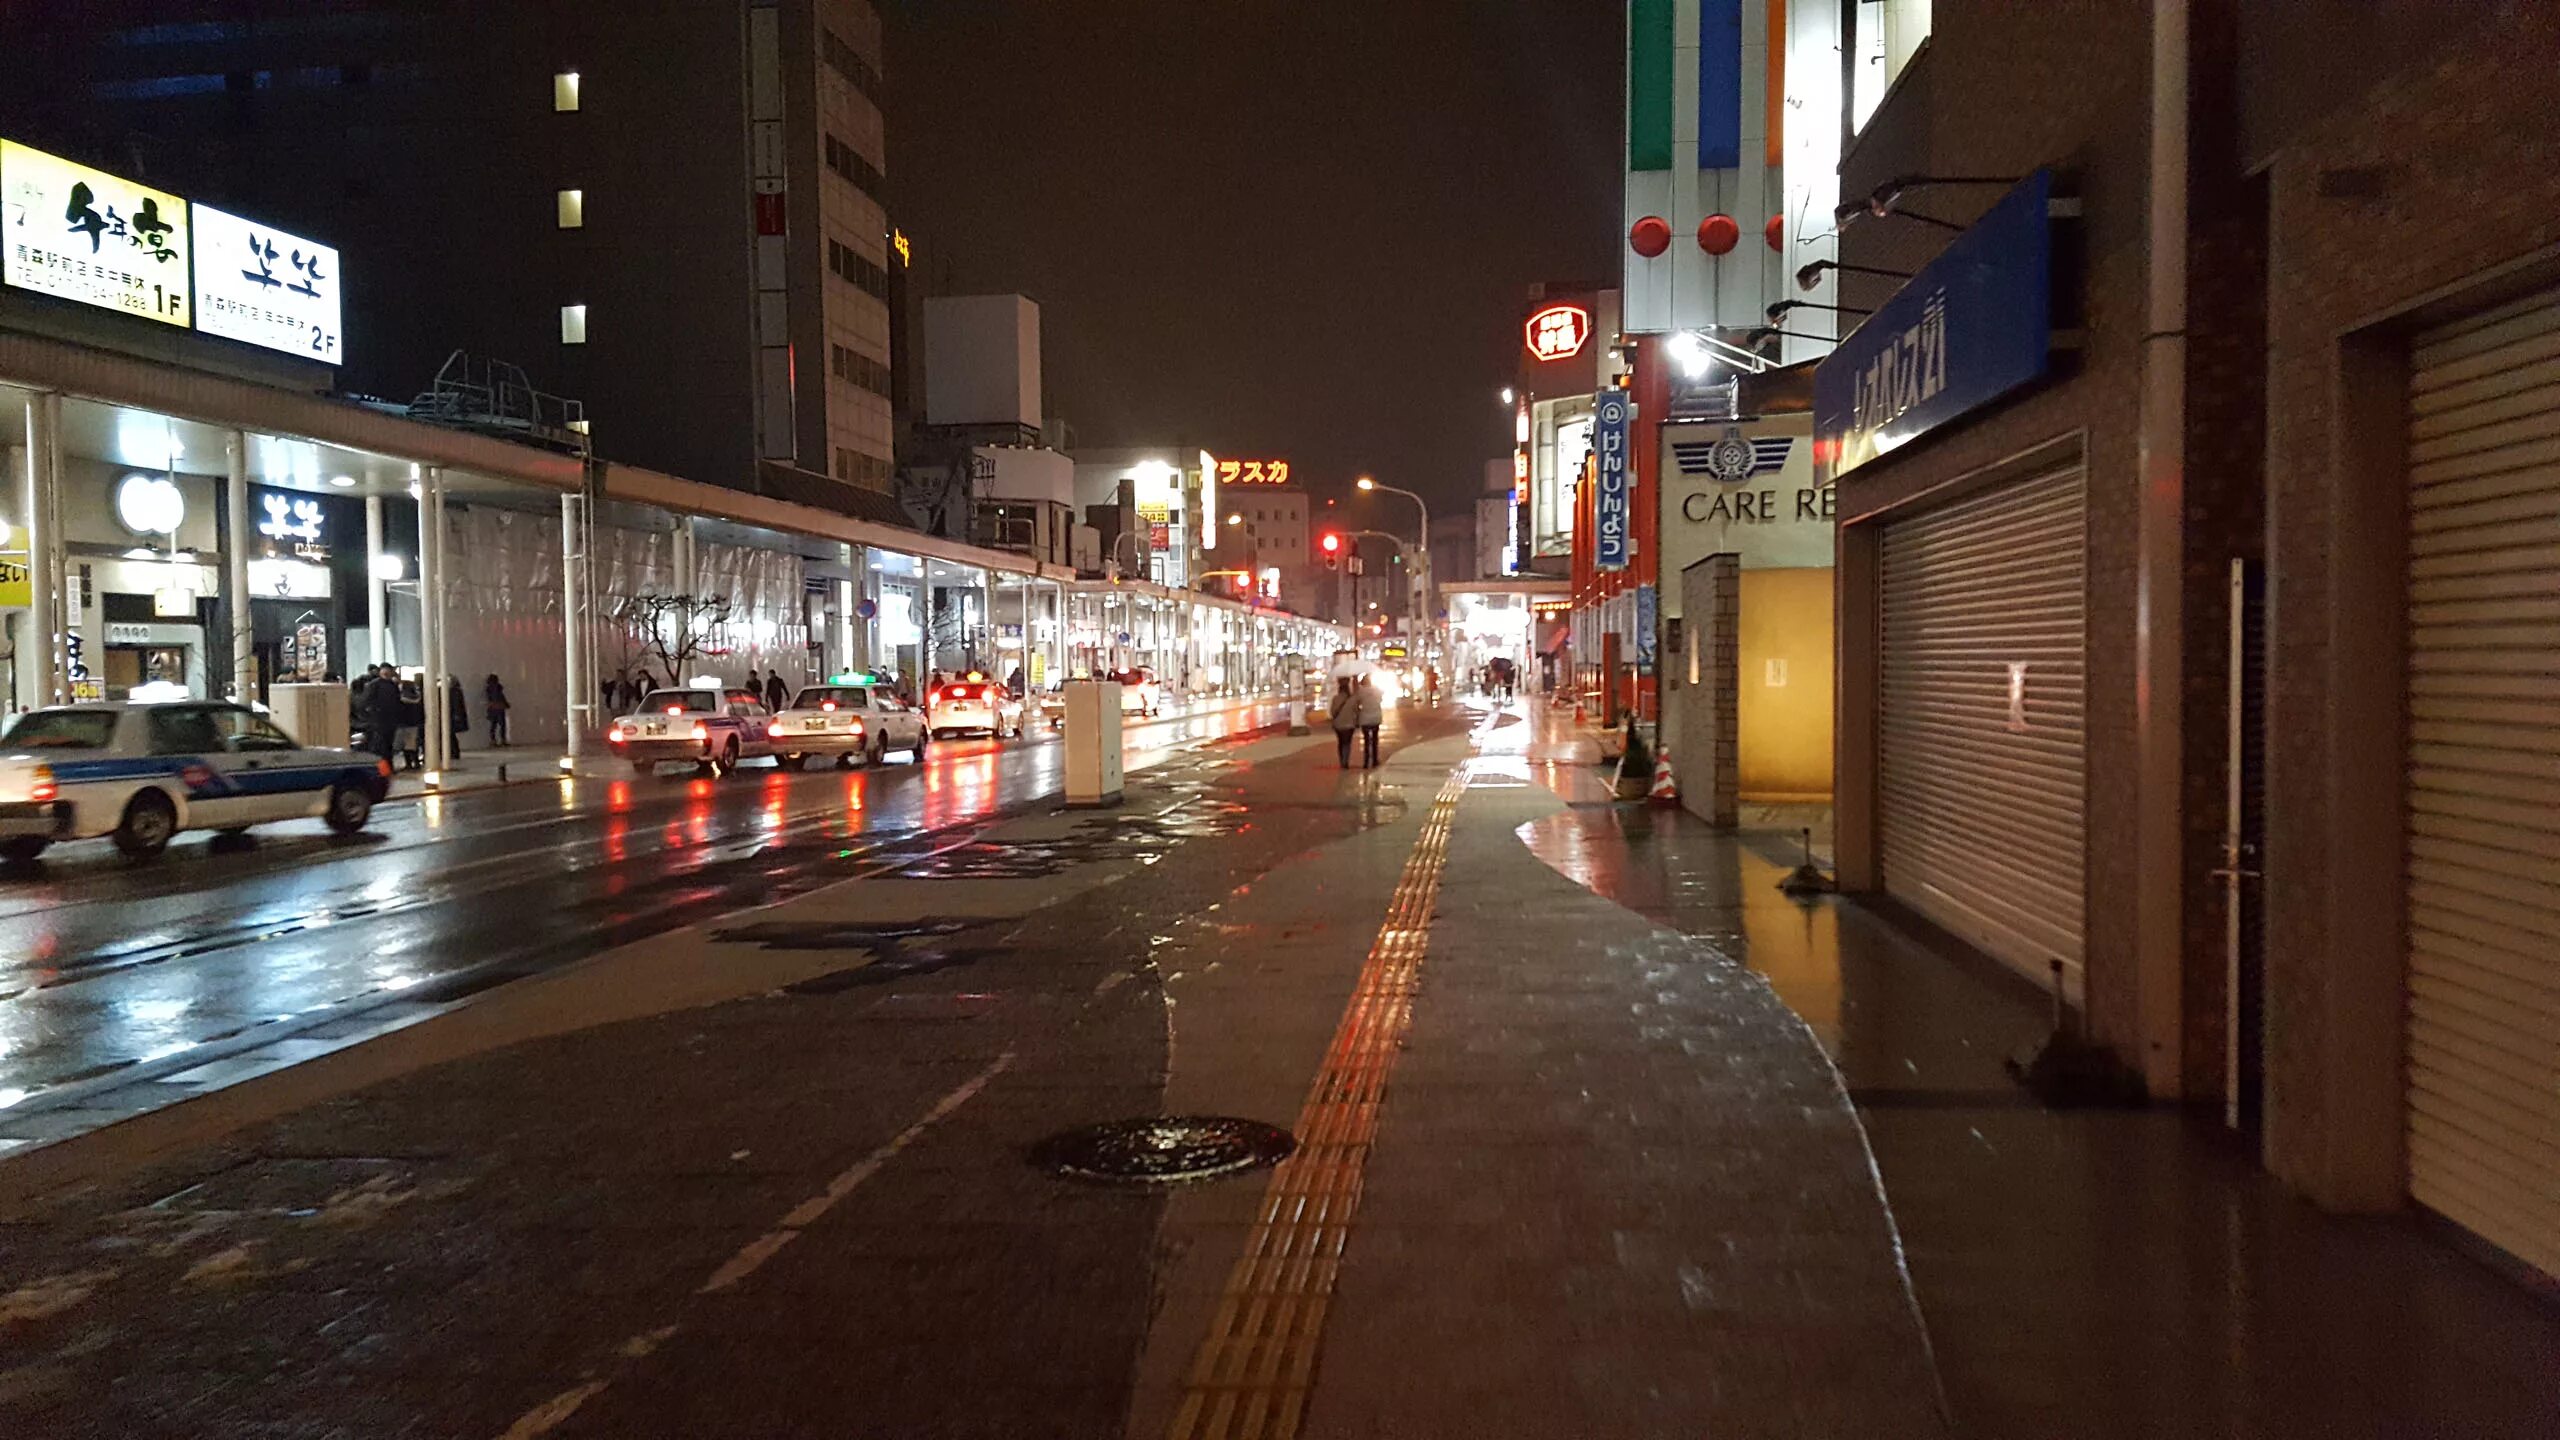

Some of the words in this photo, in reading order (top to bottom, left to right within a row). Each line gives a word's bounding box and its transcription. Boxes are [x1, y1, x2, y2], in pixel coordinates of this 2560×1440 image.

[153, 284, 181, 316] 1F
[311, 325, 335, 354] 2F
[1211, 460, 1289, 484] ラスカ
[1602, 430, 1623, 556] けんしんよう
[1682, 490, 1777, 523] CARE
